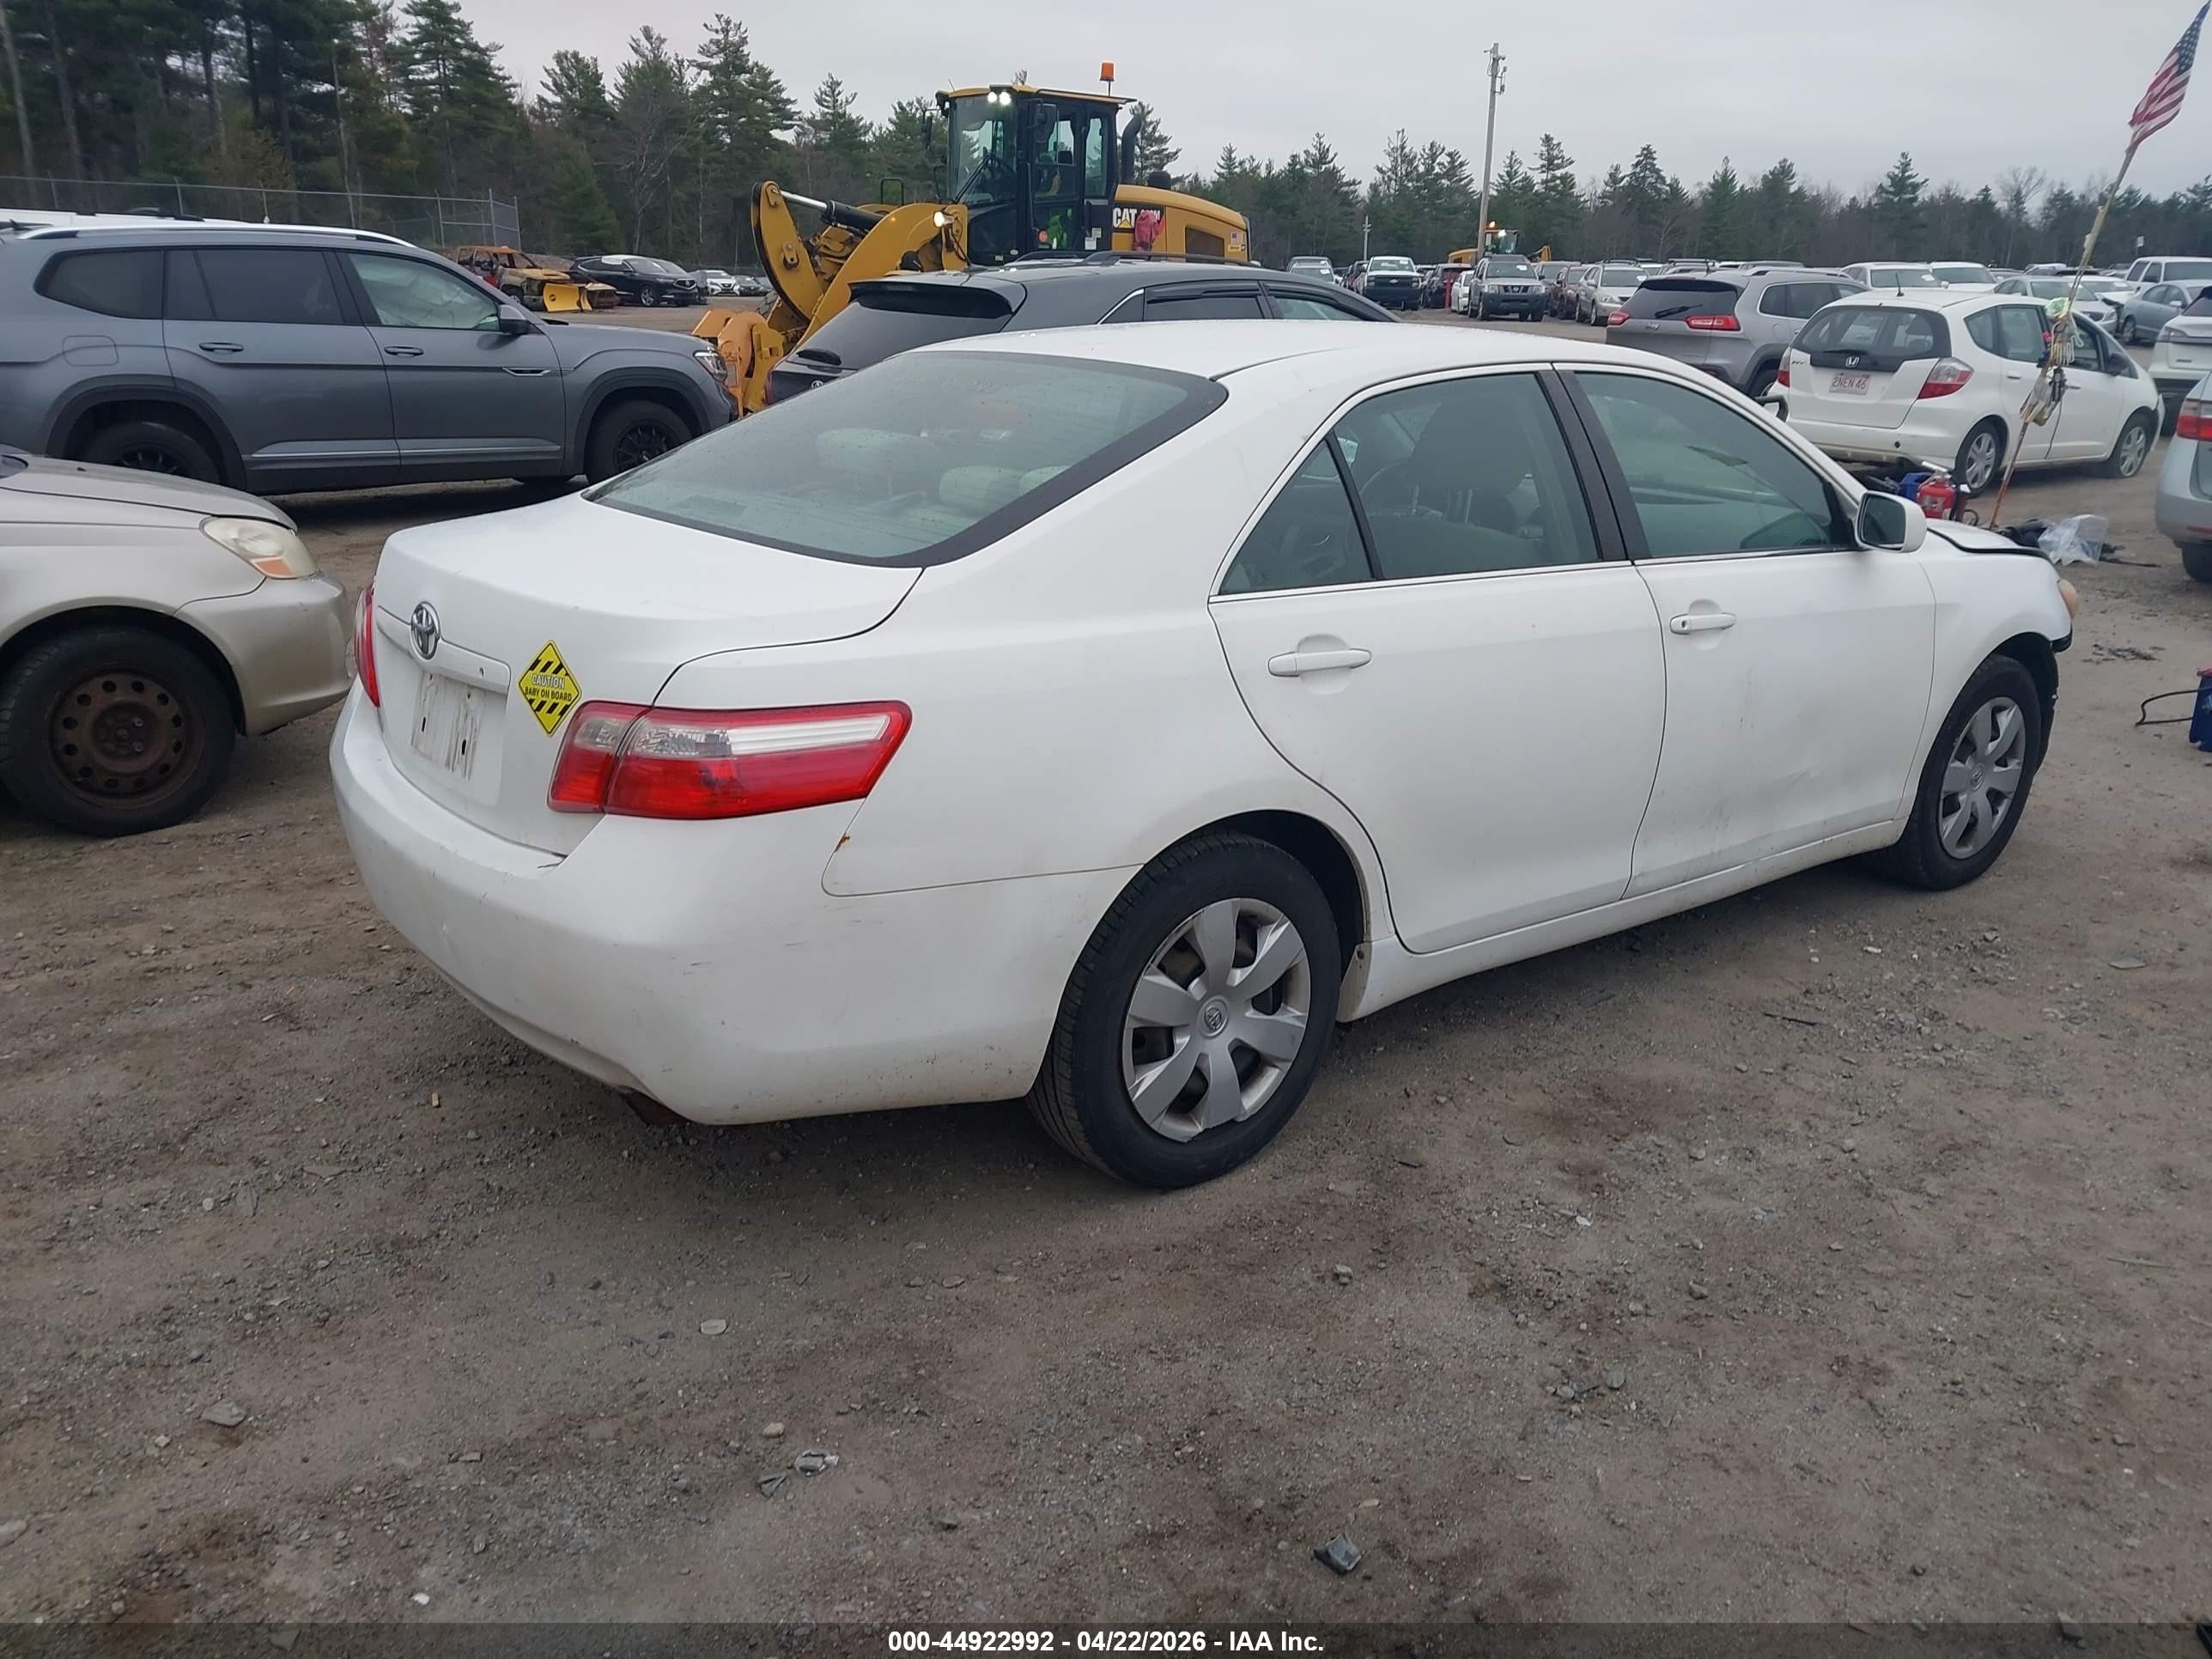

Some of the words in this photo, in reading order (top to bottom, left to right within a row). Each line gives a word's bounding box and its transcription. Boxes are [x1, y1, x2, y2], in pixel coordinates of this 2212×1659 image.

[1113, 208, 1137, 228] CAT
[1855, 378, 1867, 390] 46
[532, 675, 564, 689] CAUTION
[525, 687, 539, 697] BABY
[540, 689, 550, 698] ON
[550, 690, 572, 702] BOARD
